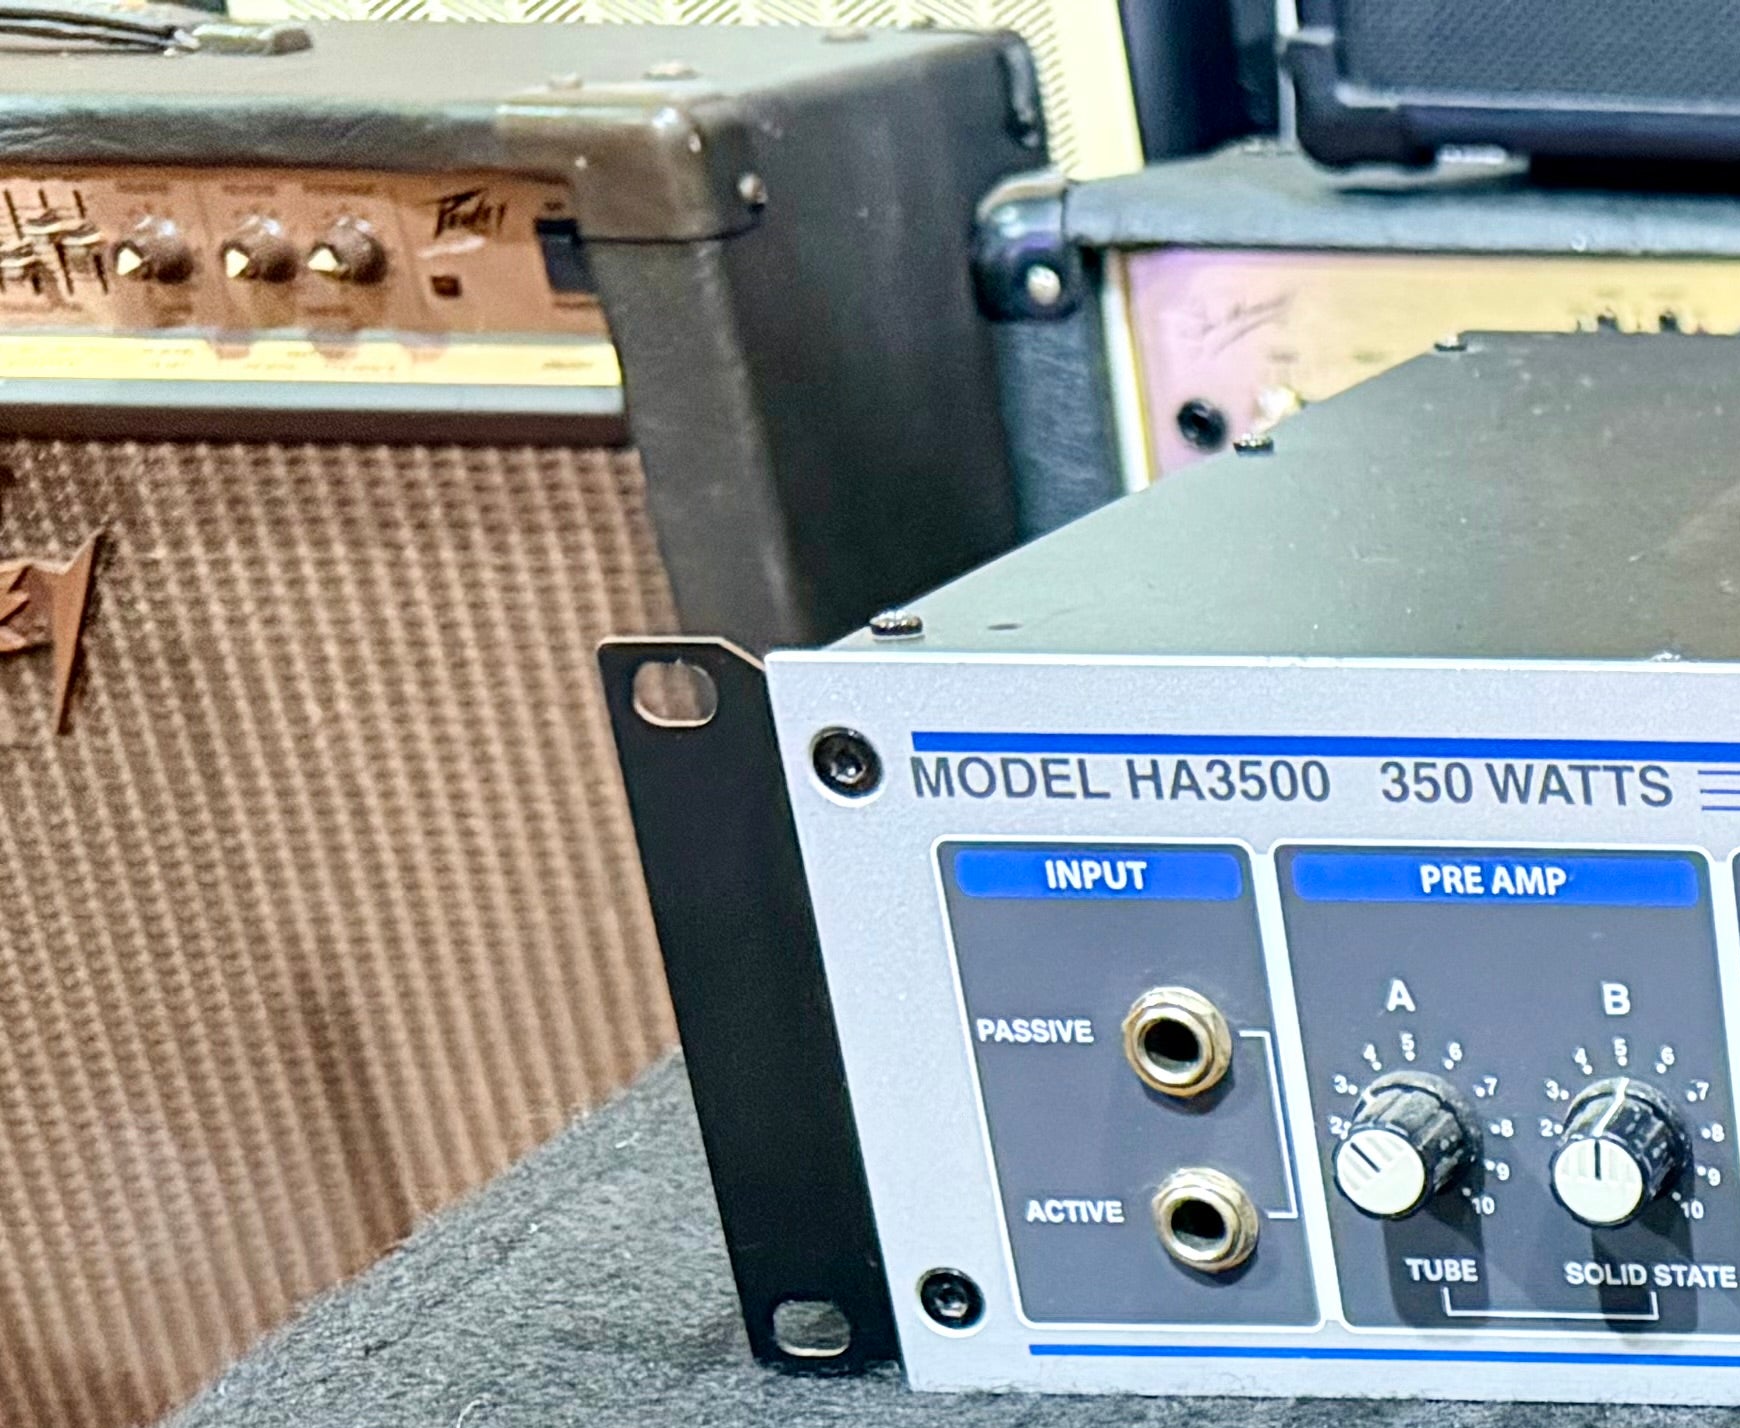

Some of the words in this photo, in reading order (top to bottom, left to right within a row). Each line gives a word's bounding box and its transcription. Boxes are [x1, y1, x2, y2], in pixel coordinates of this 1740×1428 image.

[911, 757, 1109, 799] MODEL
[1127, 759, 1330, 802] HA3500
[1381, 762, 1473, 804] 350
[1482, 764, 1674, 806] WATTS
[1045, 860, 1146, 890] INPUT
[1420, 864, 1483, 894] PRE
[1492, 865, 1566, 895] AMP
[1386, 979, 1415, 1012] A
[1603, 983, 1630, 1015] B
[977, 1019, 1094, 1043] PASSIVE
[1402, 1034, 1414, 1050] 5
[1614, 1039, 1627, 1055] 5
[1363, 1044, 1376, 1061] 4
[1449, 1043, 1463, 1060] 6
[1574, 1048, 1587, 1065] 4
[1661, 1047, 1675, 1065] 6
[1334, 1075, 1348, 1093] 3
[1484, 1078, 1498, 1095] 7
[1546, 1081, 1560, 1099] 3
[1697, 1082, 1709, 1100] 7
[1330, 1118, 1343, 1134] 2
[1500, 1120, 1513, 1136] 8
[1541, 1120, 1554, 1136] 2
[1711, 1124, 1724, 1141] 8
[1497, 1164, 1509, 1180] 9
[1708, 1169, 1721, 1186] 9
[1025, 1200, 1125, 1224] ACTIVE
[1473, 1198, 1495, 1215] 10
[1681, 1201, 1703, 1219] 10
[1405, 1258, 1479, 1282] TUBE
[1564, 1262, 1647, 1285] SOLID
[1654, 1265, 1738, 1289] STATE
